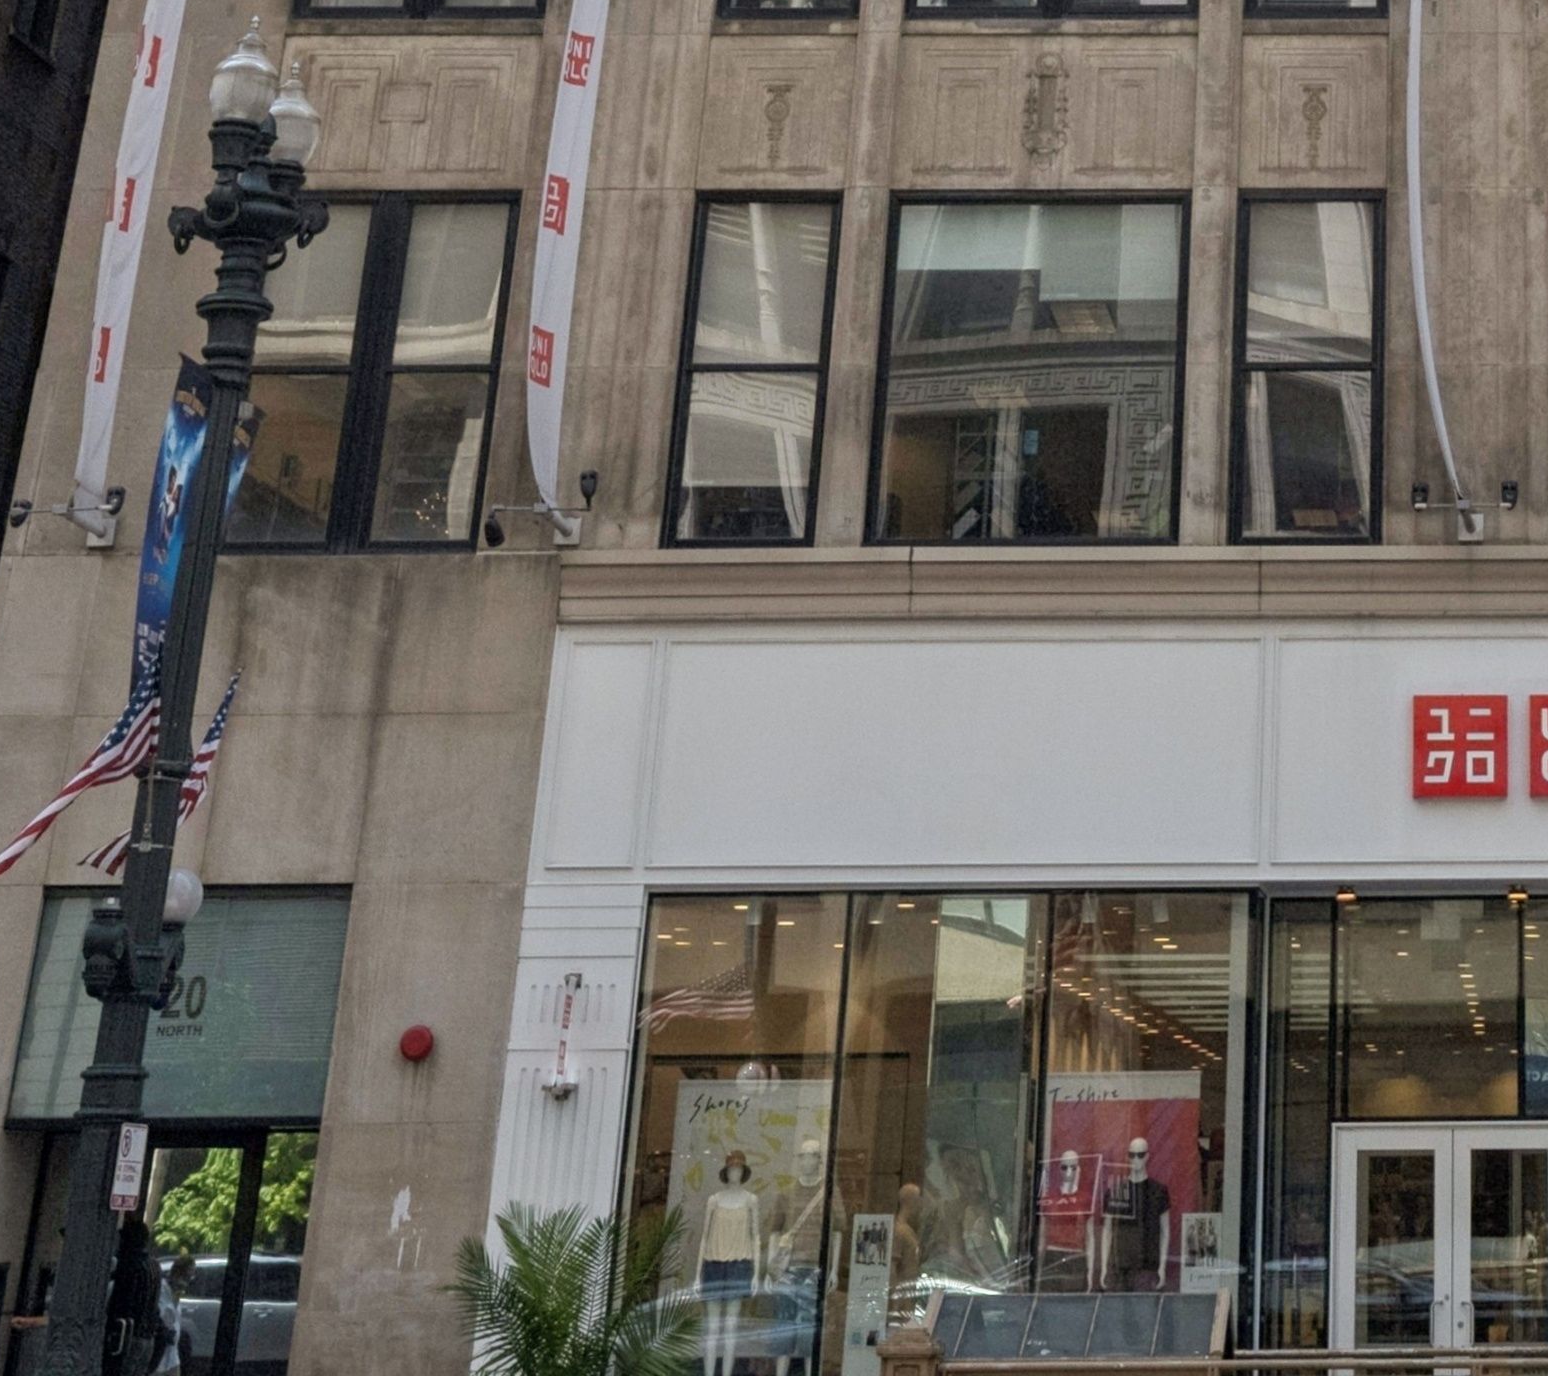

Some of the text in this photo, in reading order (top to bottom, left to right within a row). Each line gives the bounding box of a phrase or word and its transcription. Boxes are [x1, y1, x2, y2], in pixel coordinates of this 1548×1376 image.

[1425, 707, 1495, 742] ユニ
[1423, 750, 1496, 785] クロ
[159, 975, 207, 1020] 20
[156, 1024, 203, 1037] NORTH
